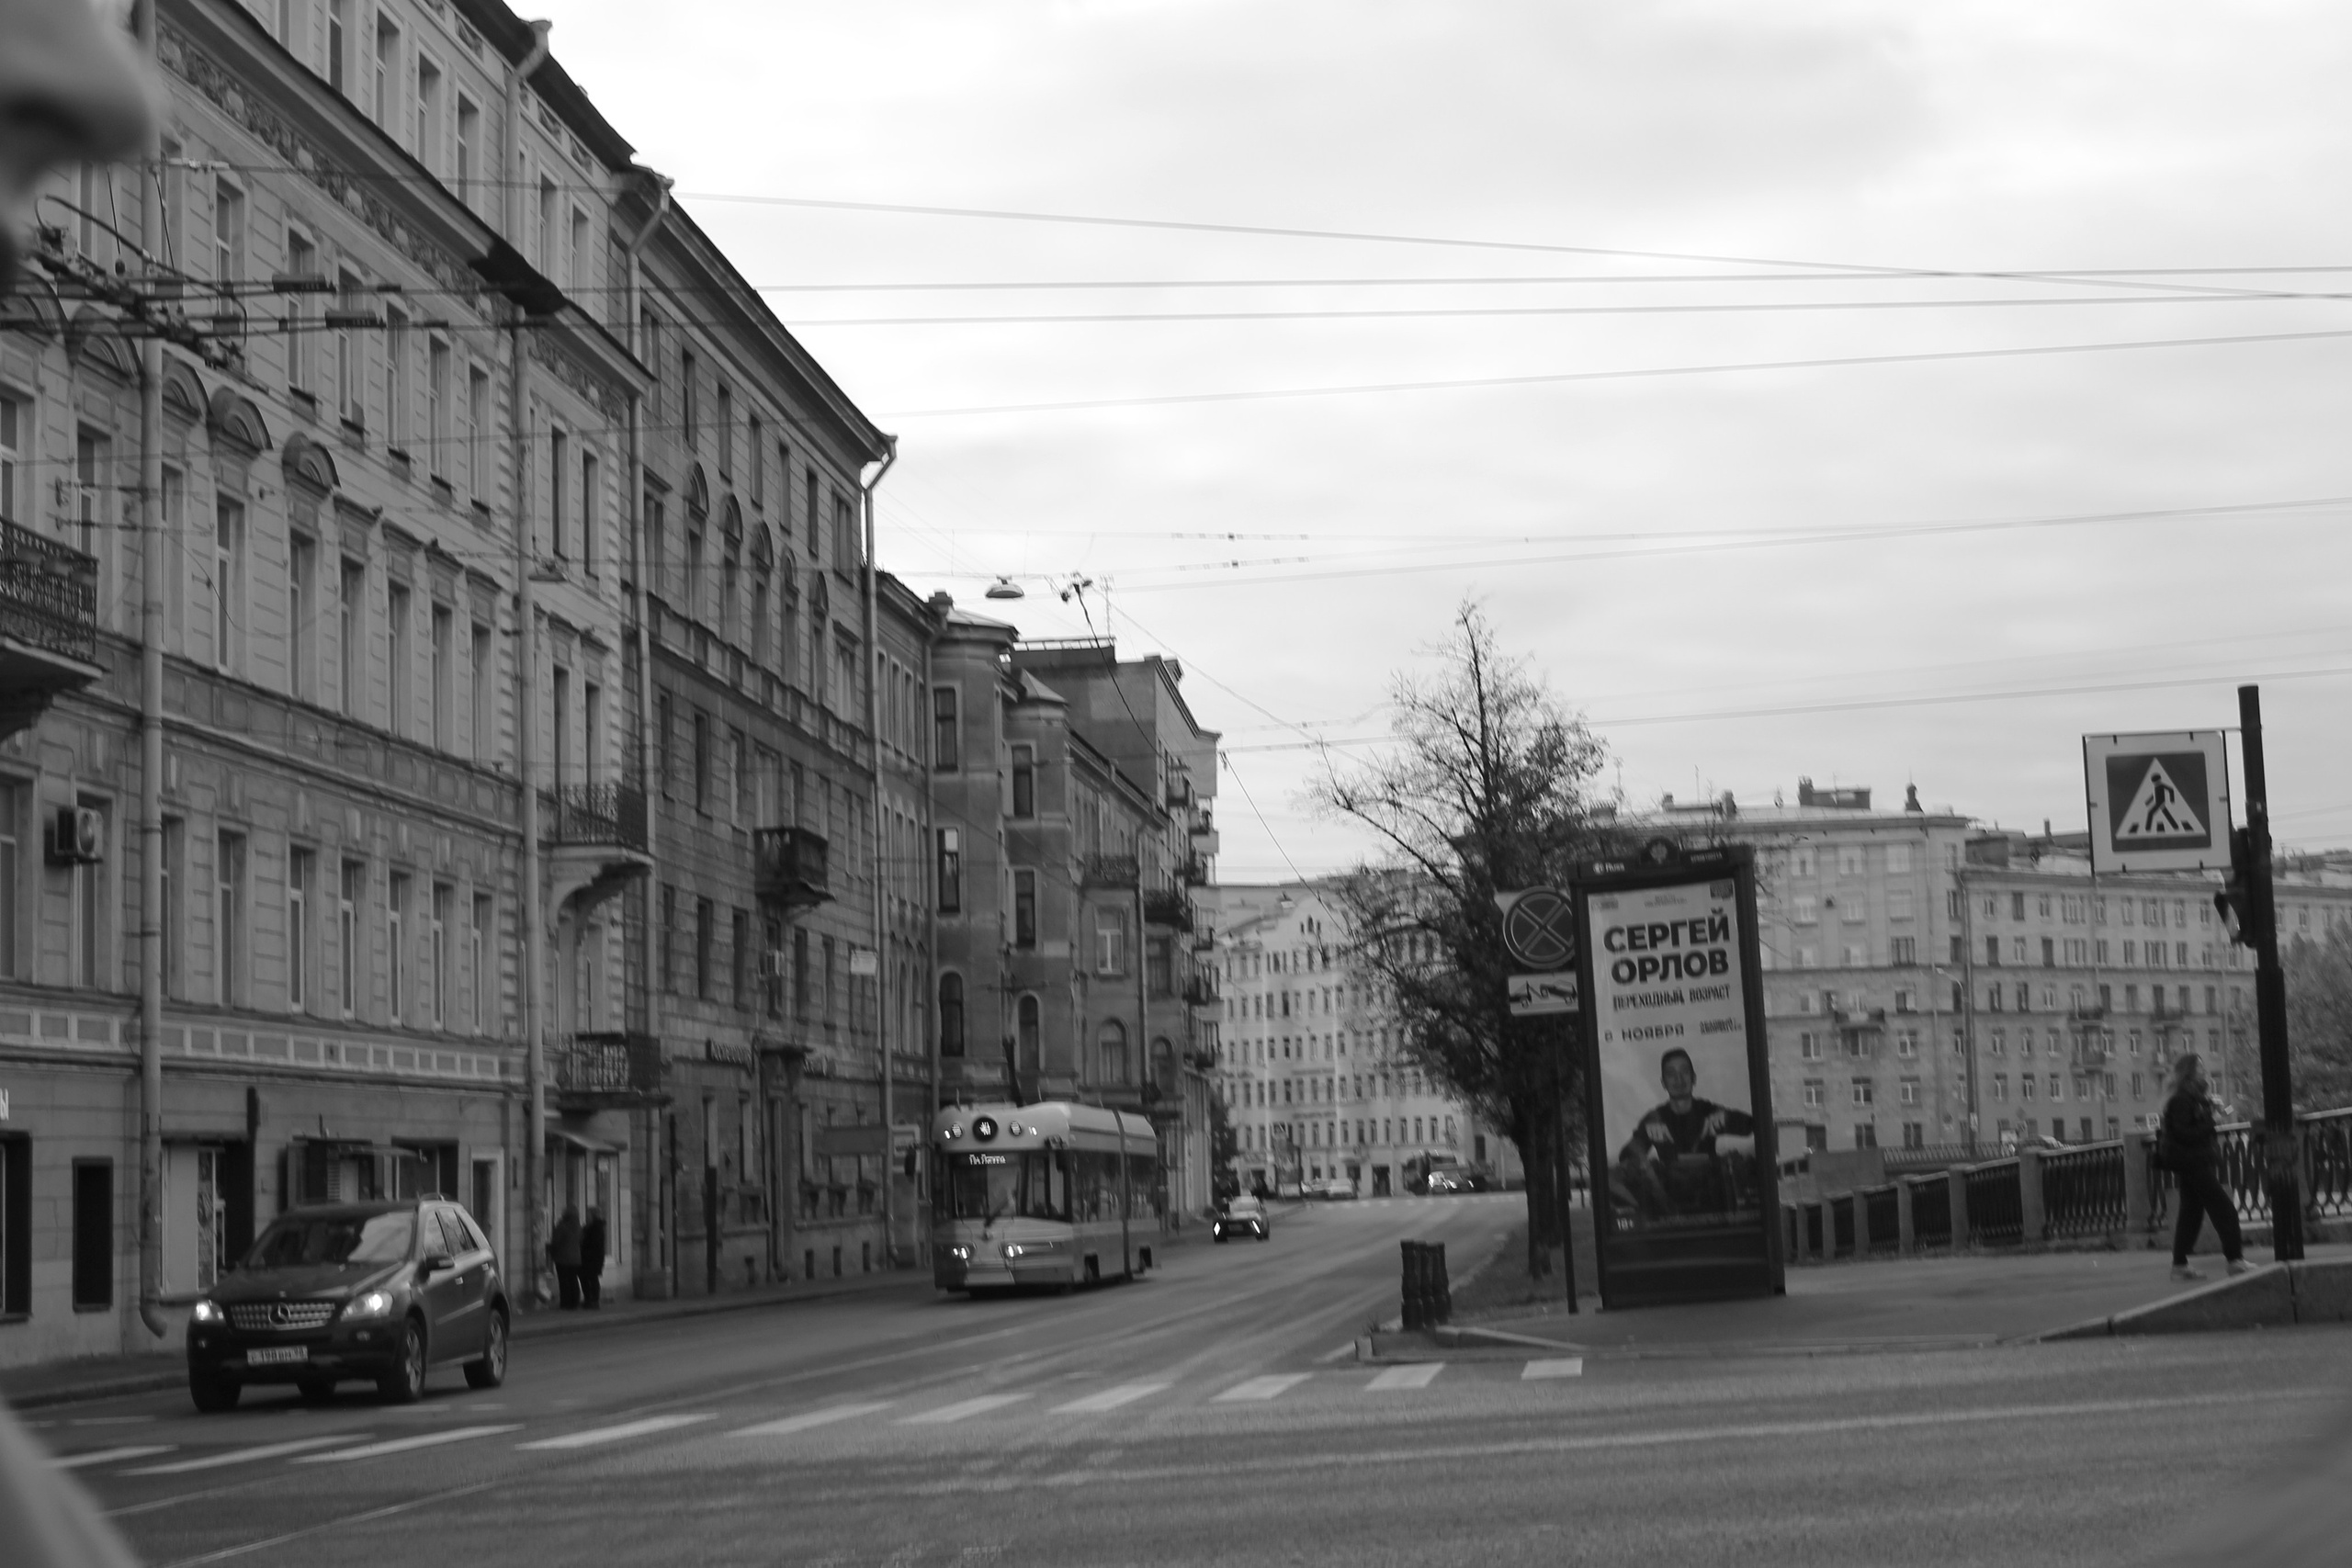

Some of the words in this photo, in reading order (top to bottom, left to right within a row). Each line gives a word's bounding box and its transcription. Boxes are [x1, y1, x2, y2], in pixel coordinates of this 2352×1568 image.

[1603, 907, 1730, 953] СЕРГЕЙ
[1611, 947, 1729, 985] ОРЛОВ
[1612, 987, 1685, 1011] ПЕРЕХОДНЫЙ
[1689, 984, 1731, 1004] ВОЗРАСТ
[1622, 1023, 1685, 1041] НОЯБРЯ
